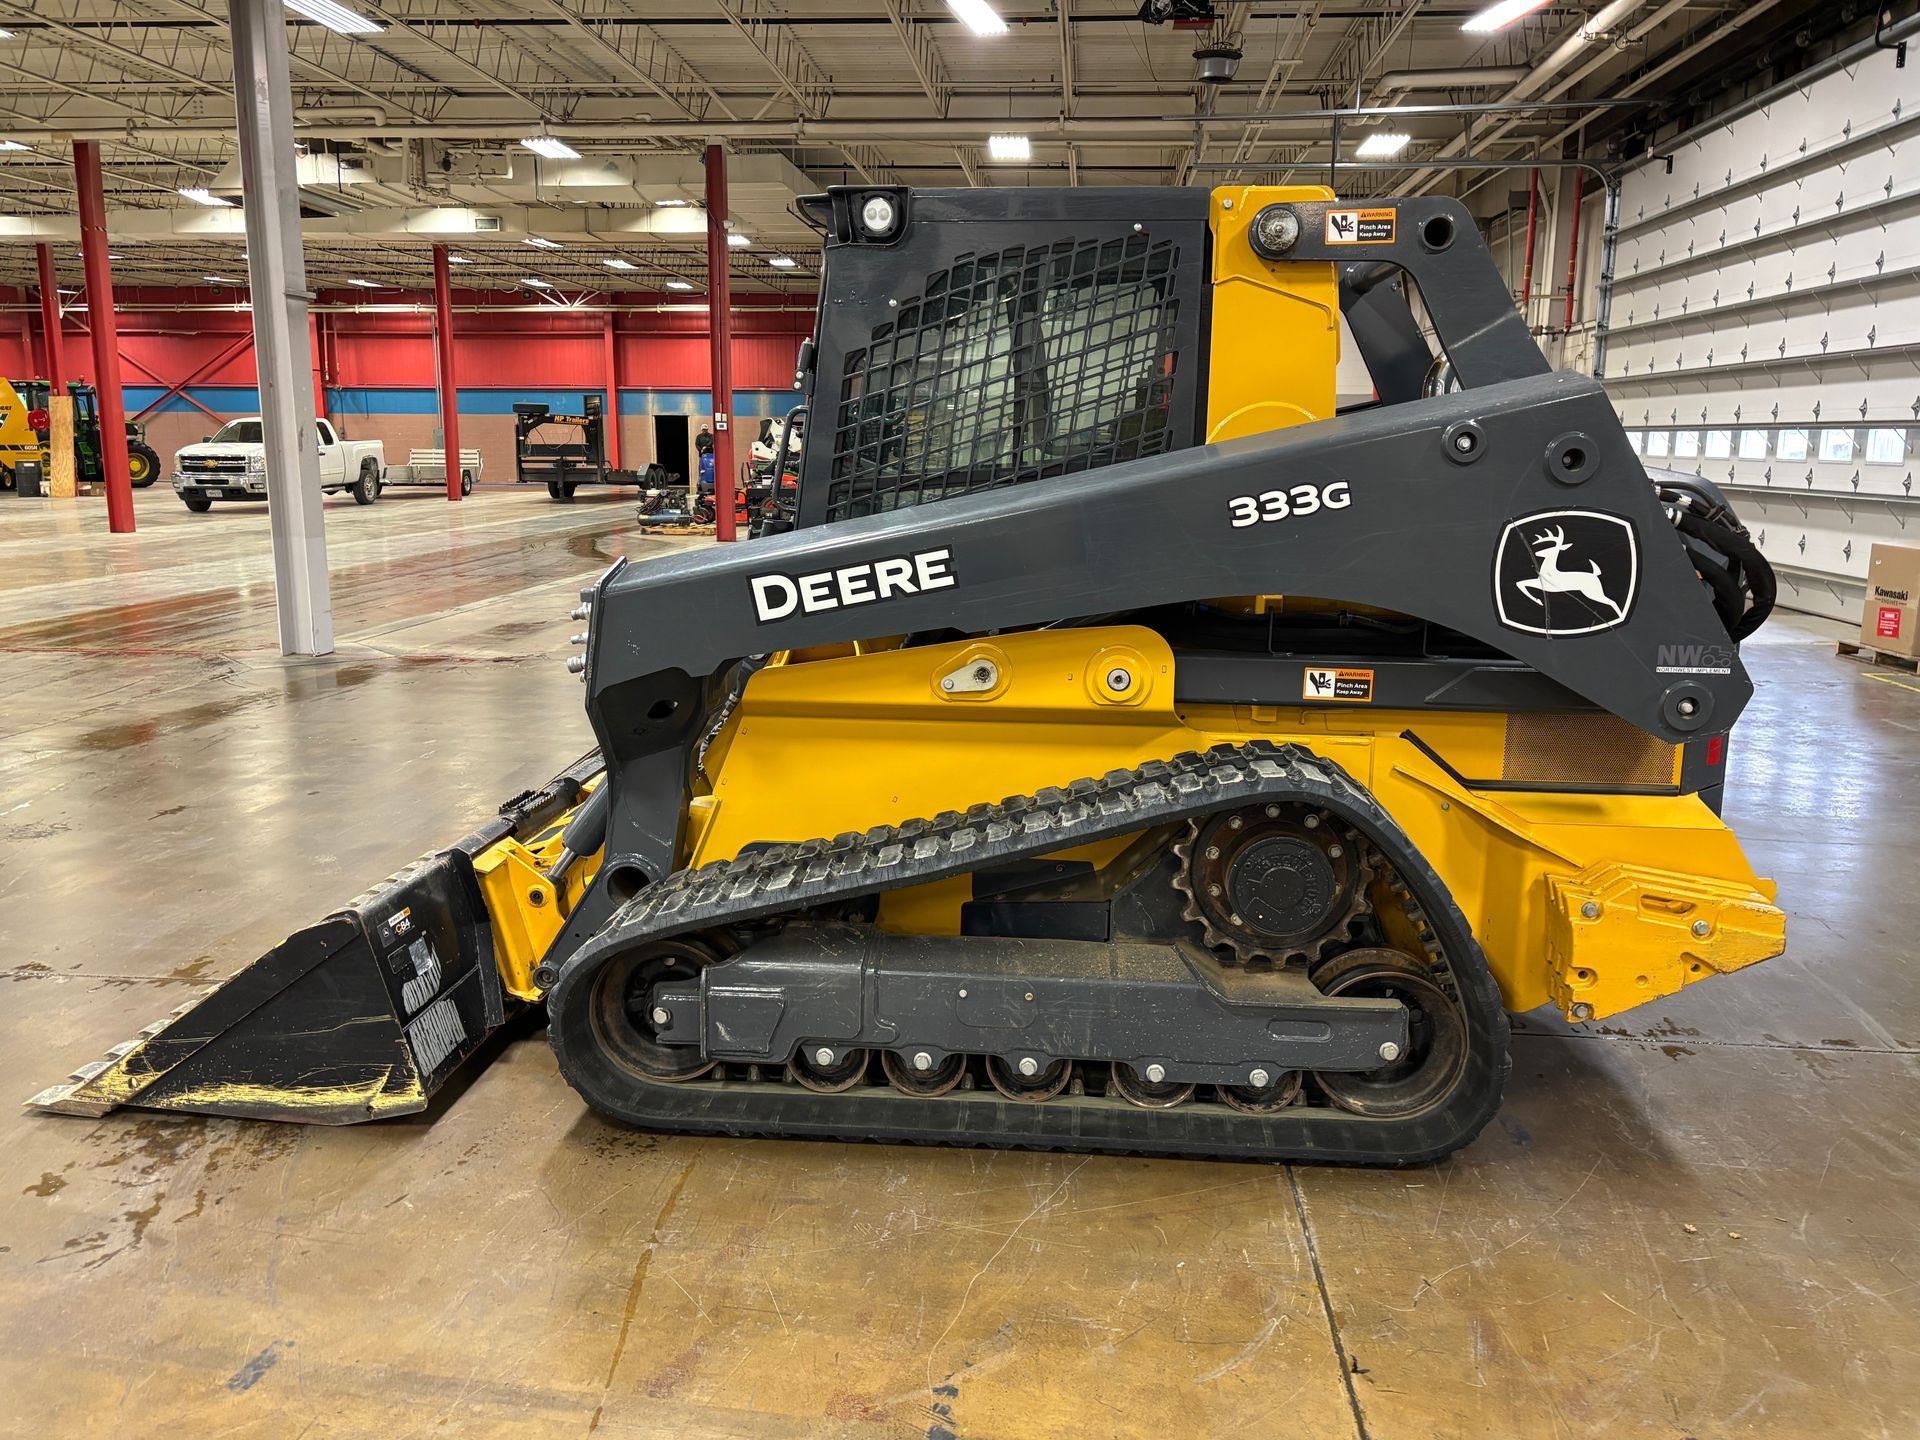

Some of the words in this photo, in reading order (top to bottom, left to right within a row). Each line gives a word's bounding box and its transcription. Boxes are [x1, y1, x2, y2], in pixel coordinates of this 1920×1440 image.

[1229, 481, 1351, 527] 333G
[751, 549, 955, 622] DEERE
[1875, 586, 1908, 600] Kawasaki
[1657, 645, 1704, 666] NW
[396, 918, 411, 933] C84
